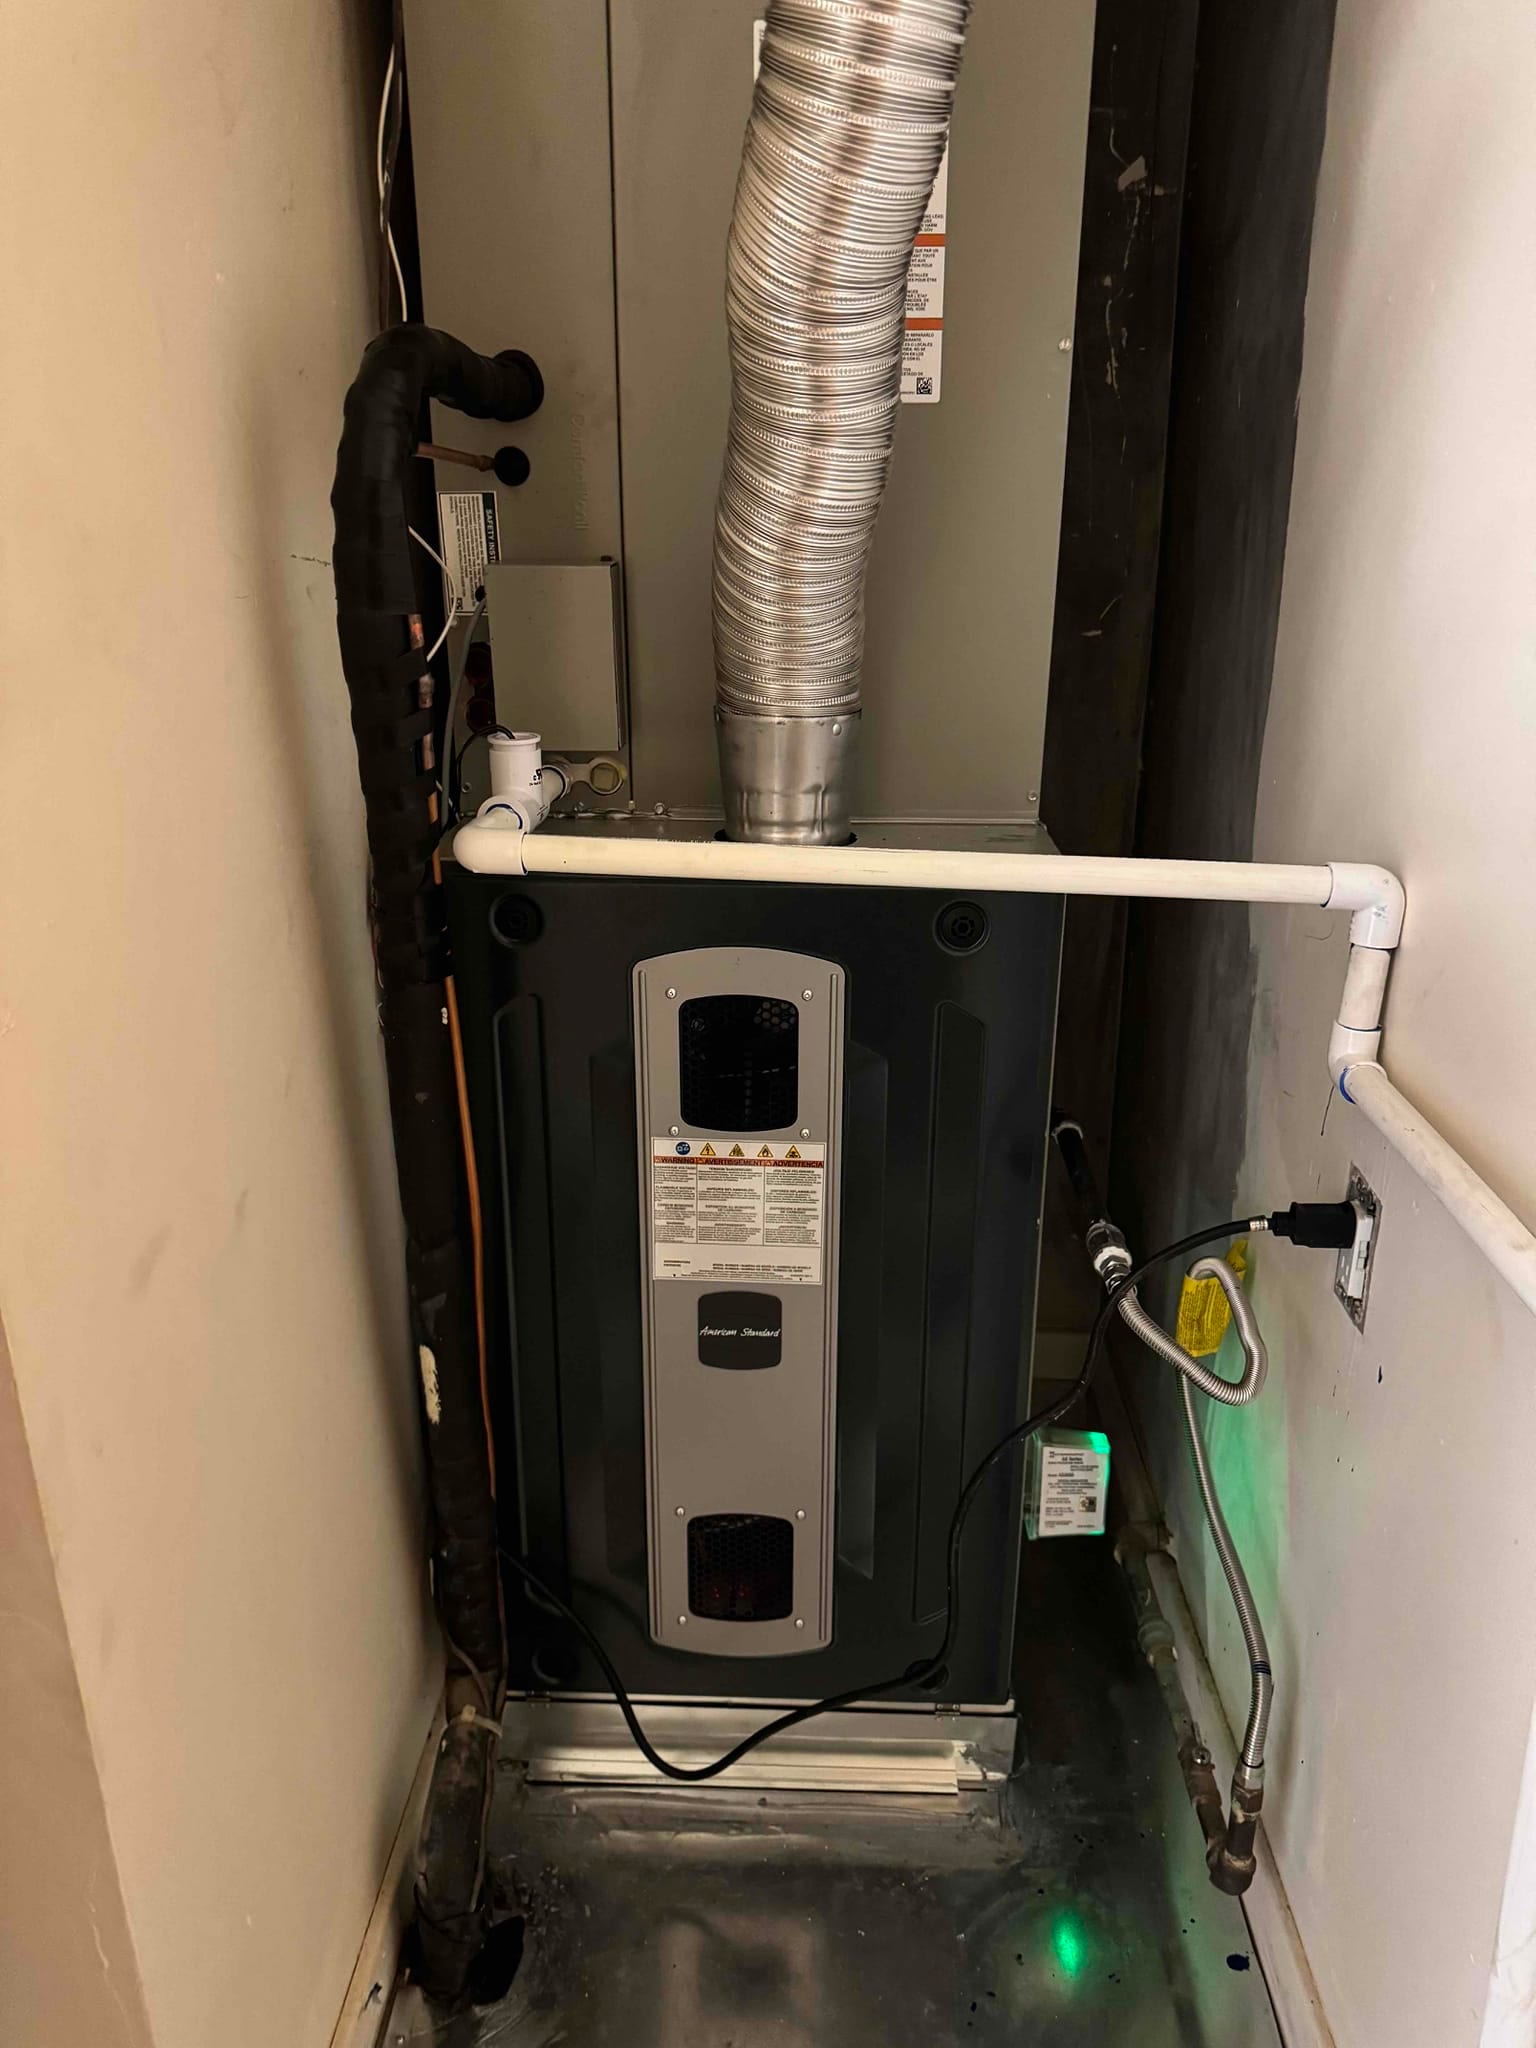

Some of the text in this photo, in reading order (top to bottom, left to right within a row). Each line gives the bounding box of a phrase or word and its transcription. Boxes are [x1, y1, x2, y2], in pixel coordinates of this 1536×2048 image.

[486, 509, 495, 540] SAFETY
[661, 1156, 695, 1164] WARNING
[705, 1157, 763, 1166] AVERTISSEMENT
[773, 1160, 823, 1168] ADVERTENCIA
[699, 1325, 781, 1337] American Standard
